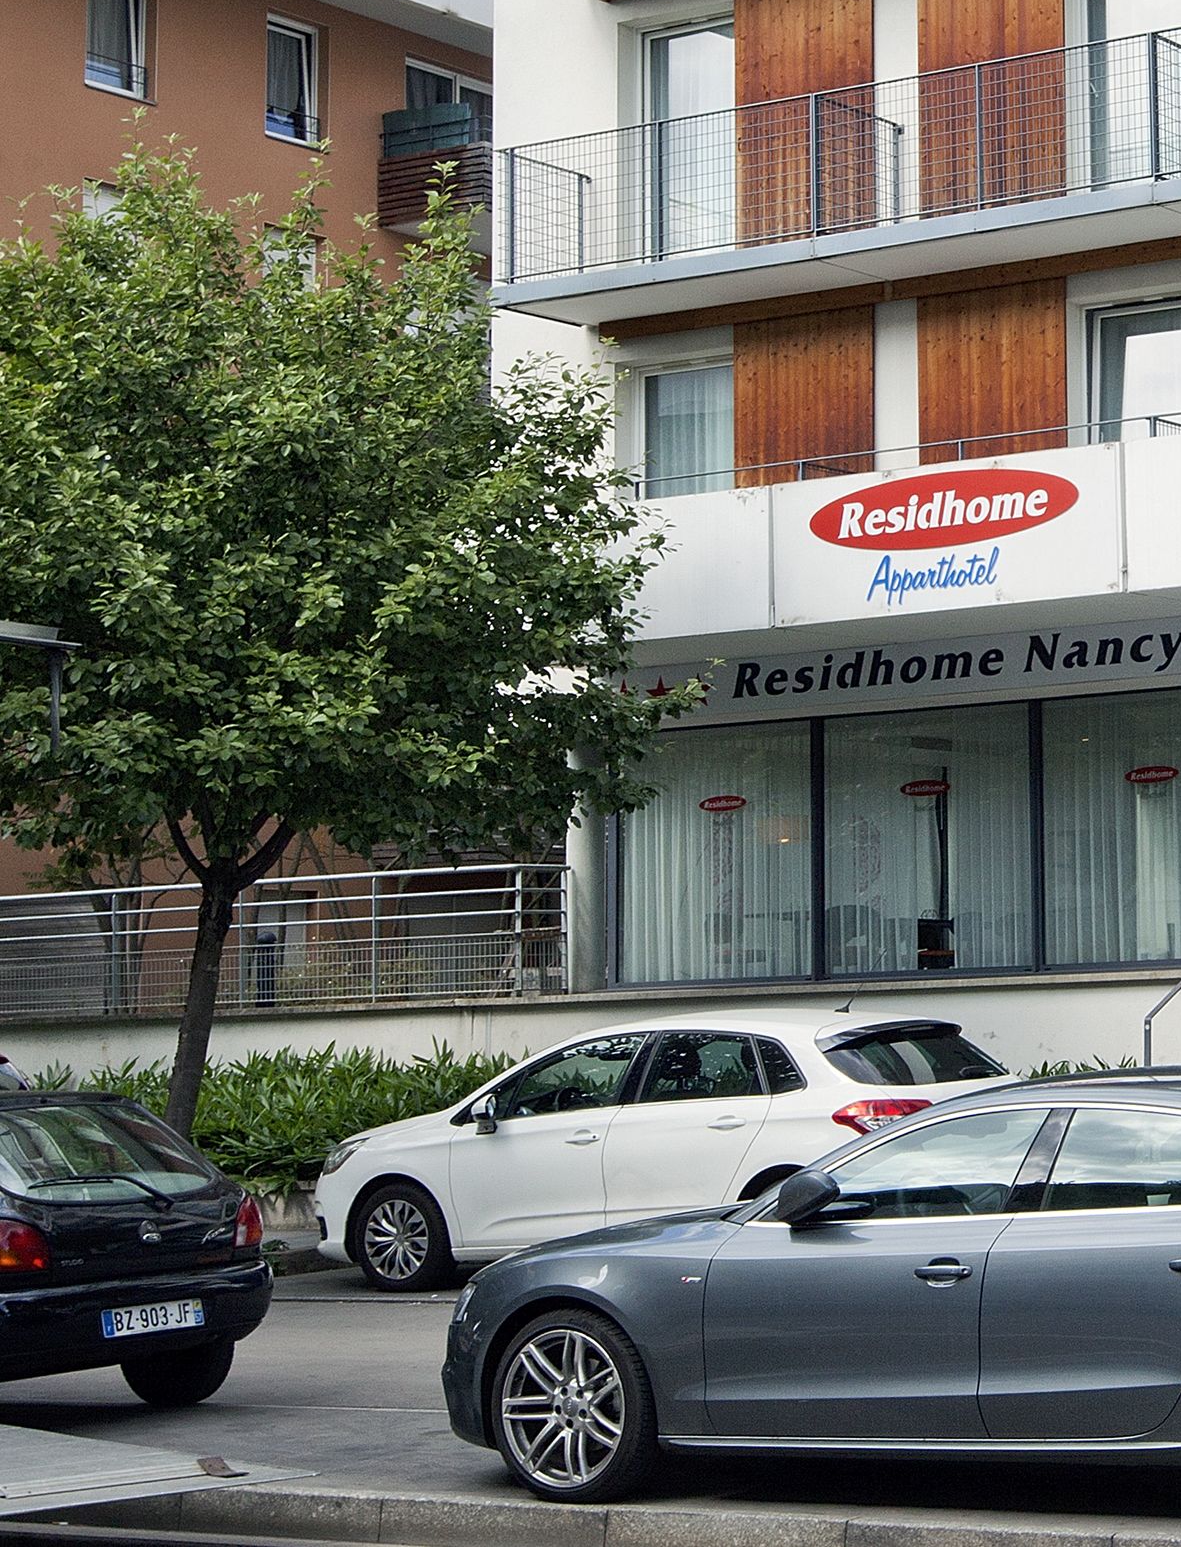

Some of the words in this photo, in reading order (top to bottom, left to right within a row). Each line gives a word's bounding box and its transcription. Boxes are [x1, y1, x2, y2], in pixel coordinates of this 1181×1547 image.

[837, 488, 1048, 540] Residhome
[867, 546, 1000, 605] Apparthotel
[732, 648, 1005, 699] Residhome
[114, 1303, 190, 1332] BZ-903-JF
